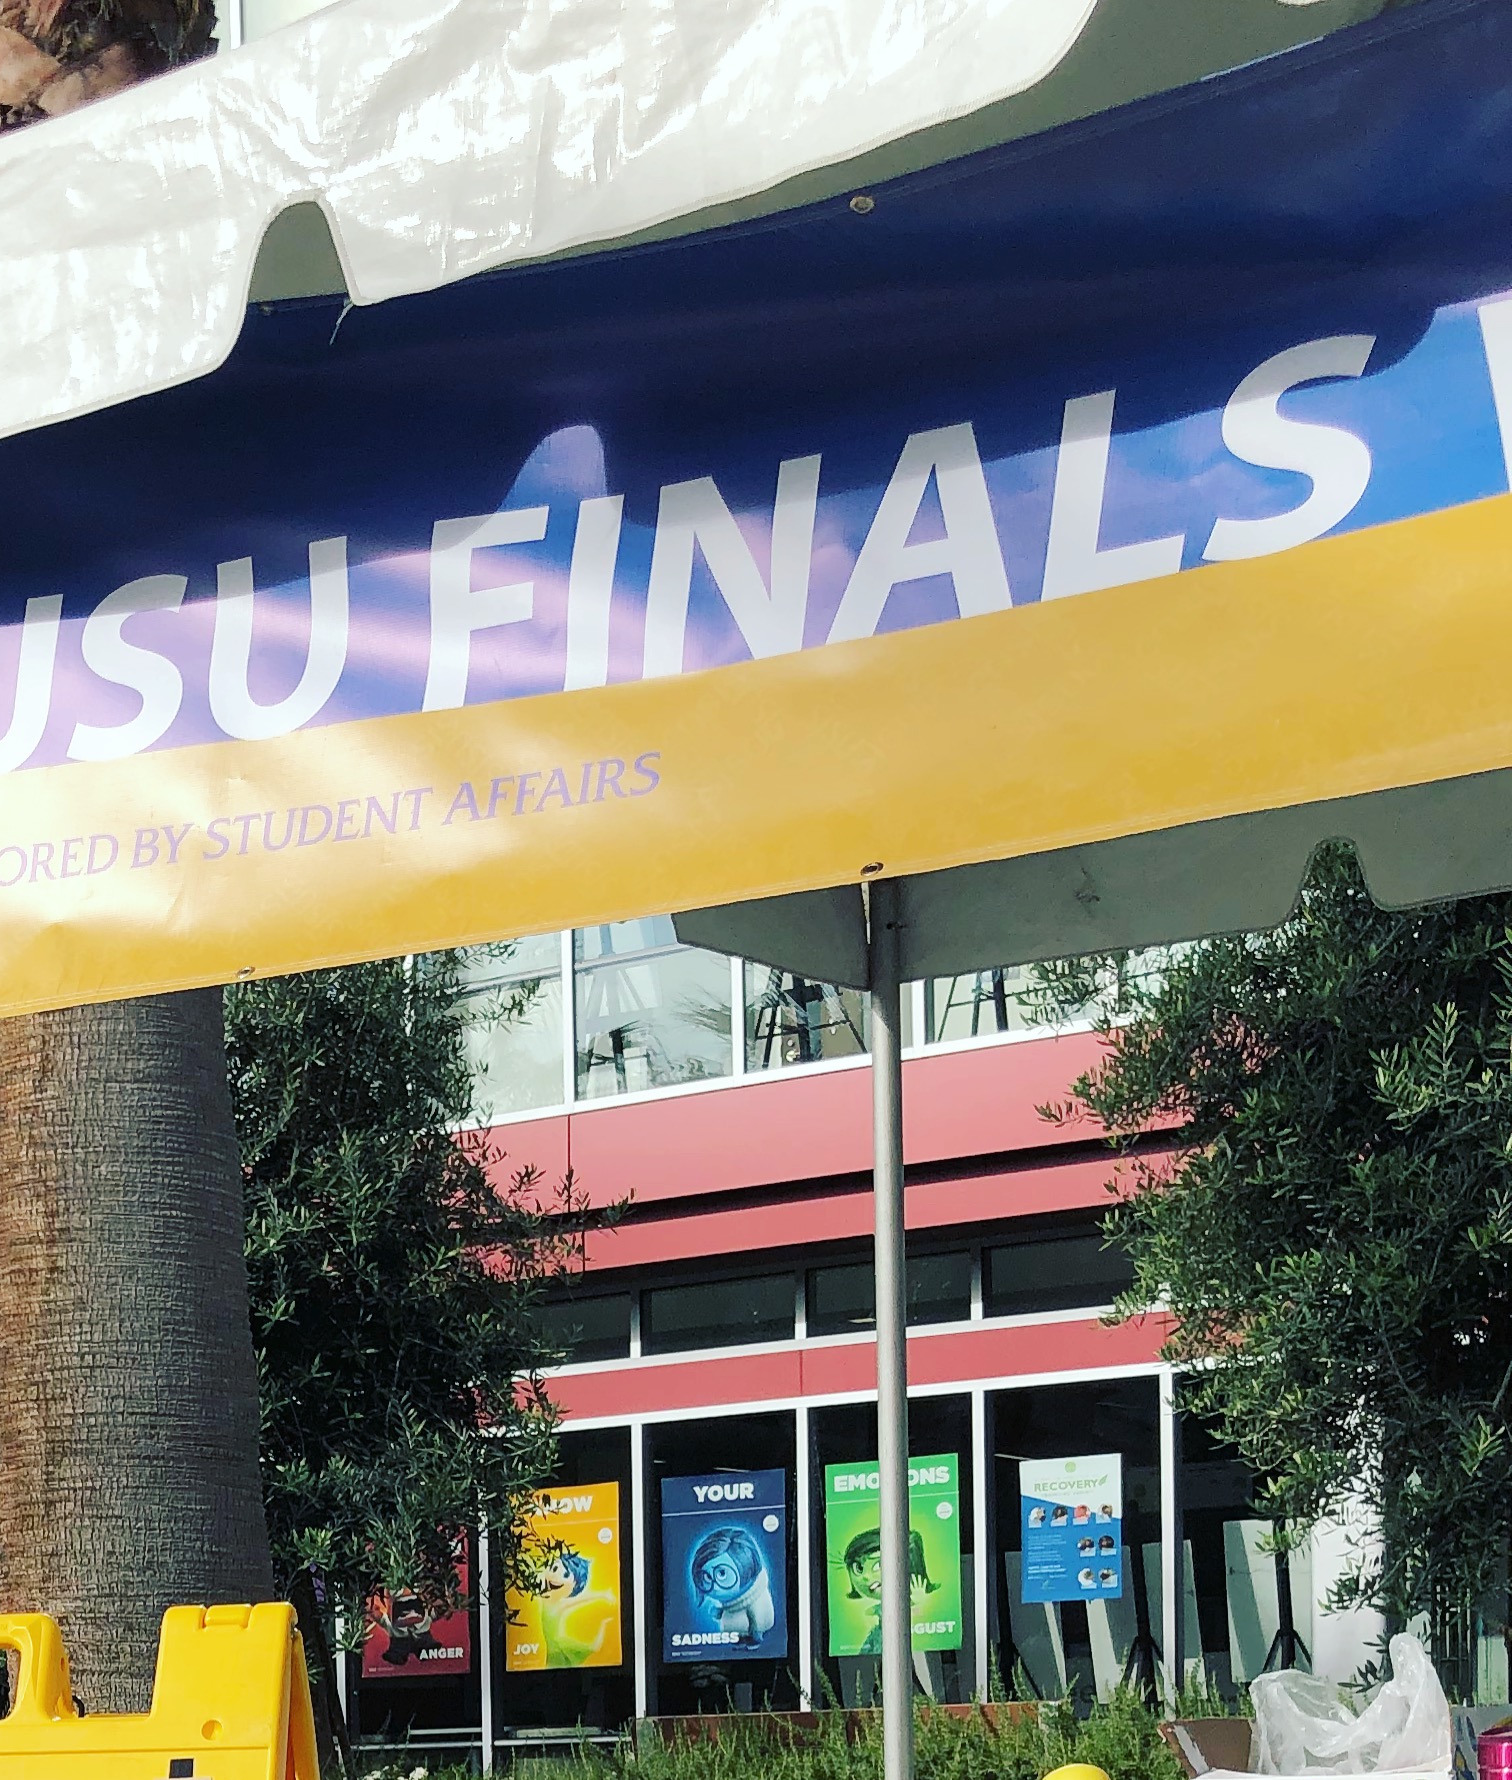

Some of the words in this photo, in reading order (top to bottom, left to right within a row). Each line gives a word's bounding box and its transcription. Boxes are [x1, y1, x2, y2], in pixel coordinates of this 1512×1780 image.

[421, 333, 1376, 712] FINALS
[130, 822, 196, 869] BY
[202, 786, 434, 861] STUDENT
[442, 751, 662, 827] AFFAIRS
[833, 1466, 950, 1493] EMOONS
[1034, 1479, 1098, 1493] RECOVERY
[693, 1482, 755, 1504] YOUR
[671, 1631, 740, 1647] SADNESS
[419, 1646, 464, 1661] ANGER
[513, 1643, 540, 1656] JOY
